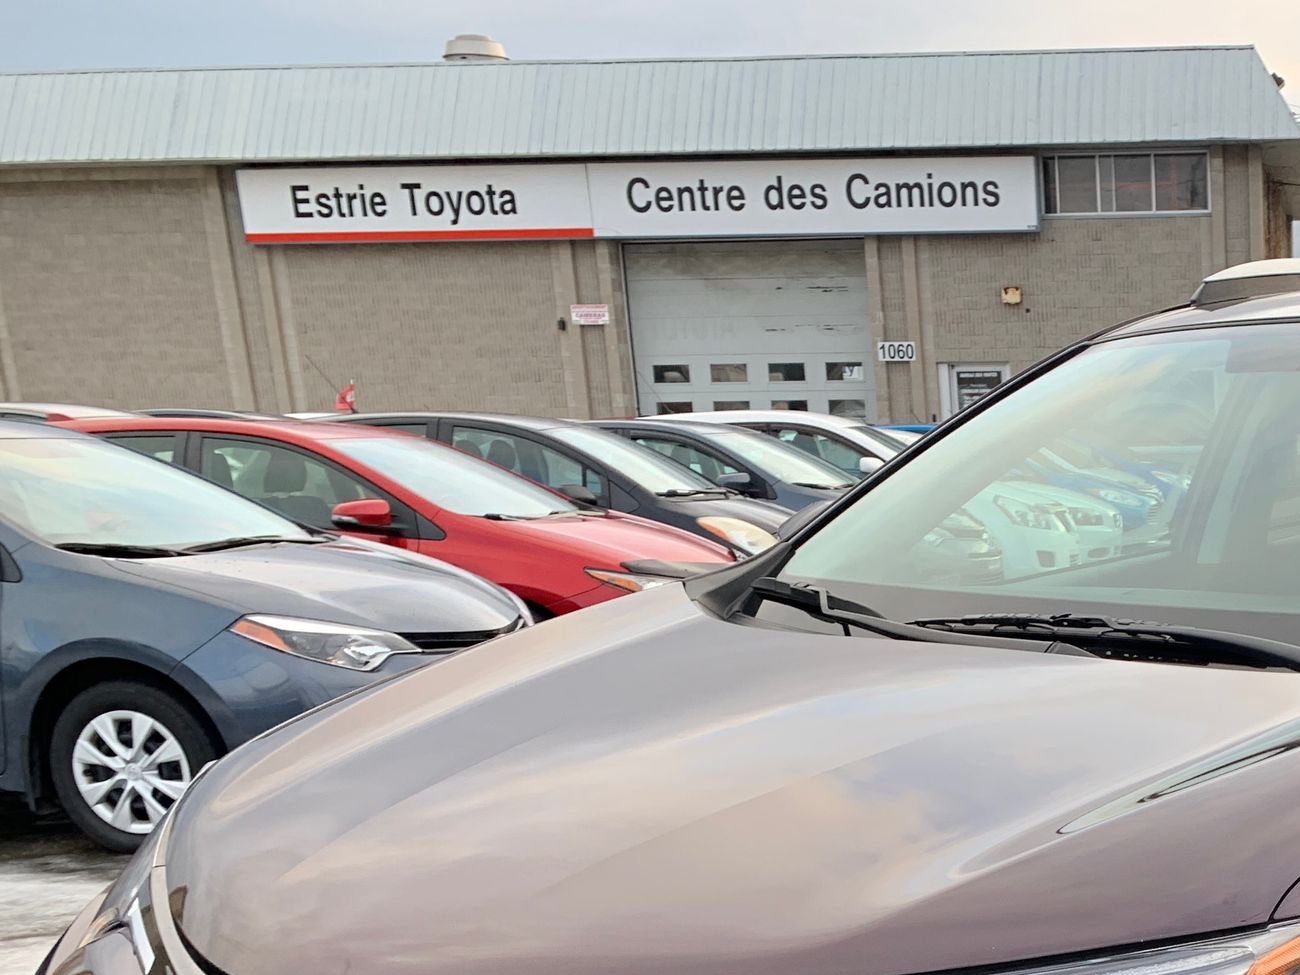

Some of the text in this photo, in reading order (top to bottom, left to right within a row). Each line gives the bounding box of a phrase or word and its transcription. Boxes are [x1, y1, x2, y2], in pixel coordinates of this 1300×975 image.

[290, 183, 517, 225] Estrie Toyota
[626, 173, 1000, 213] Centre des Camions
[879, 343, 914, 359] 1060
